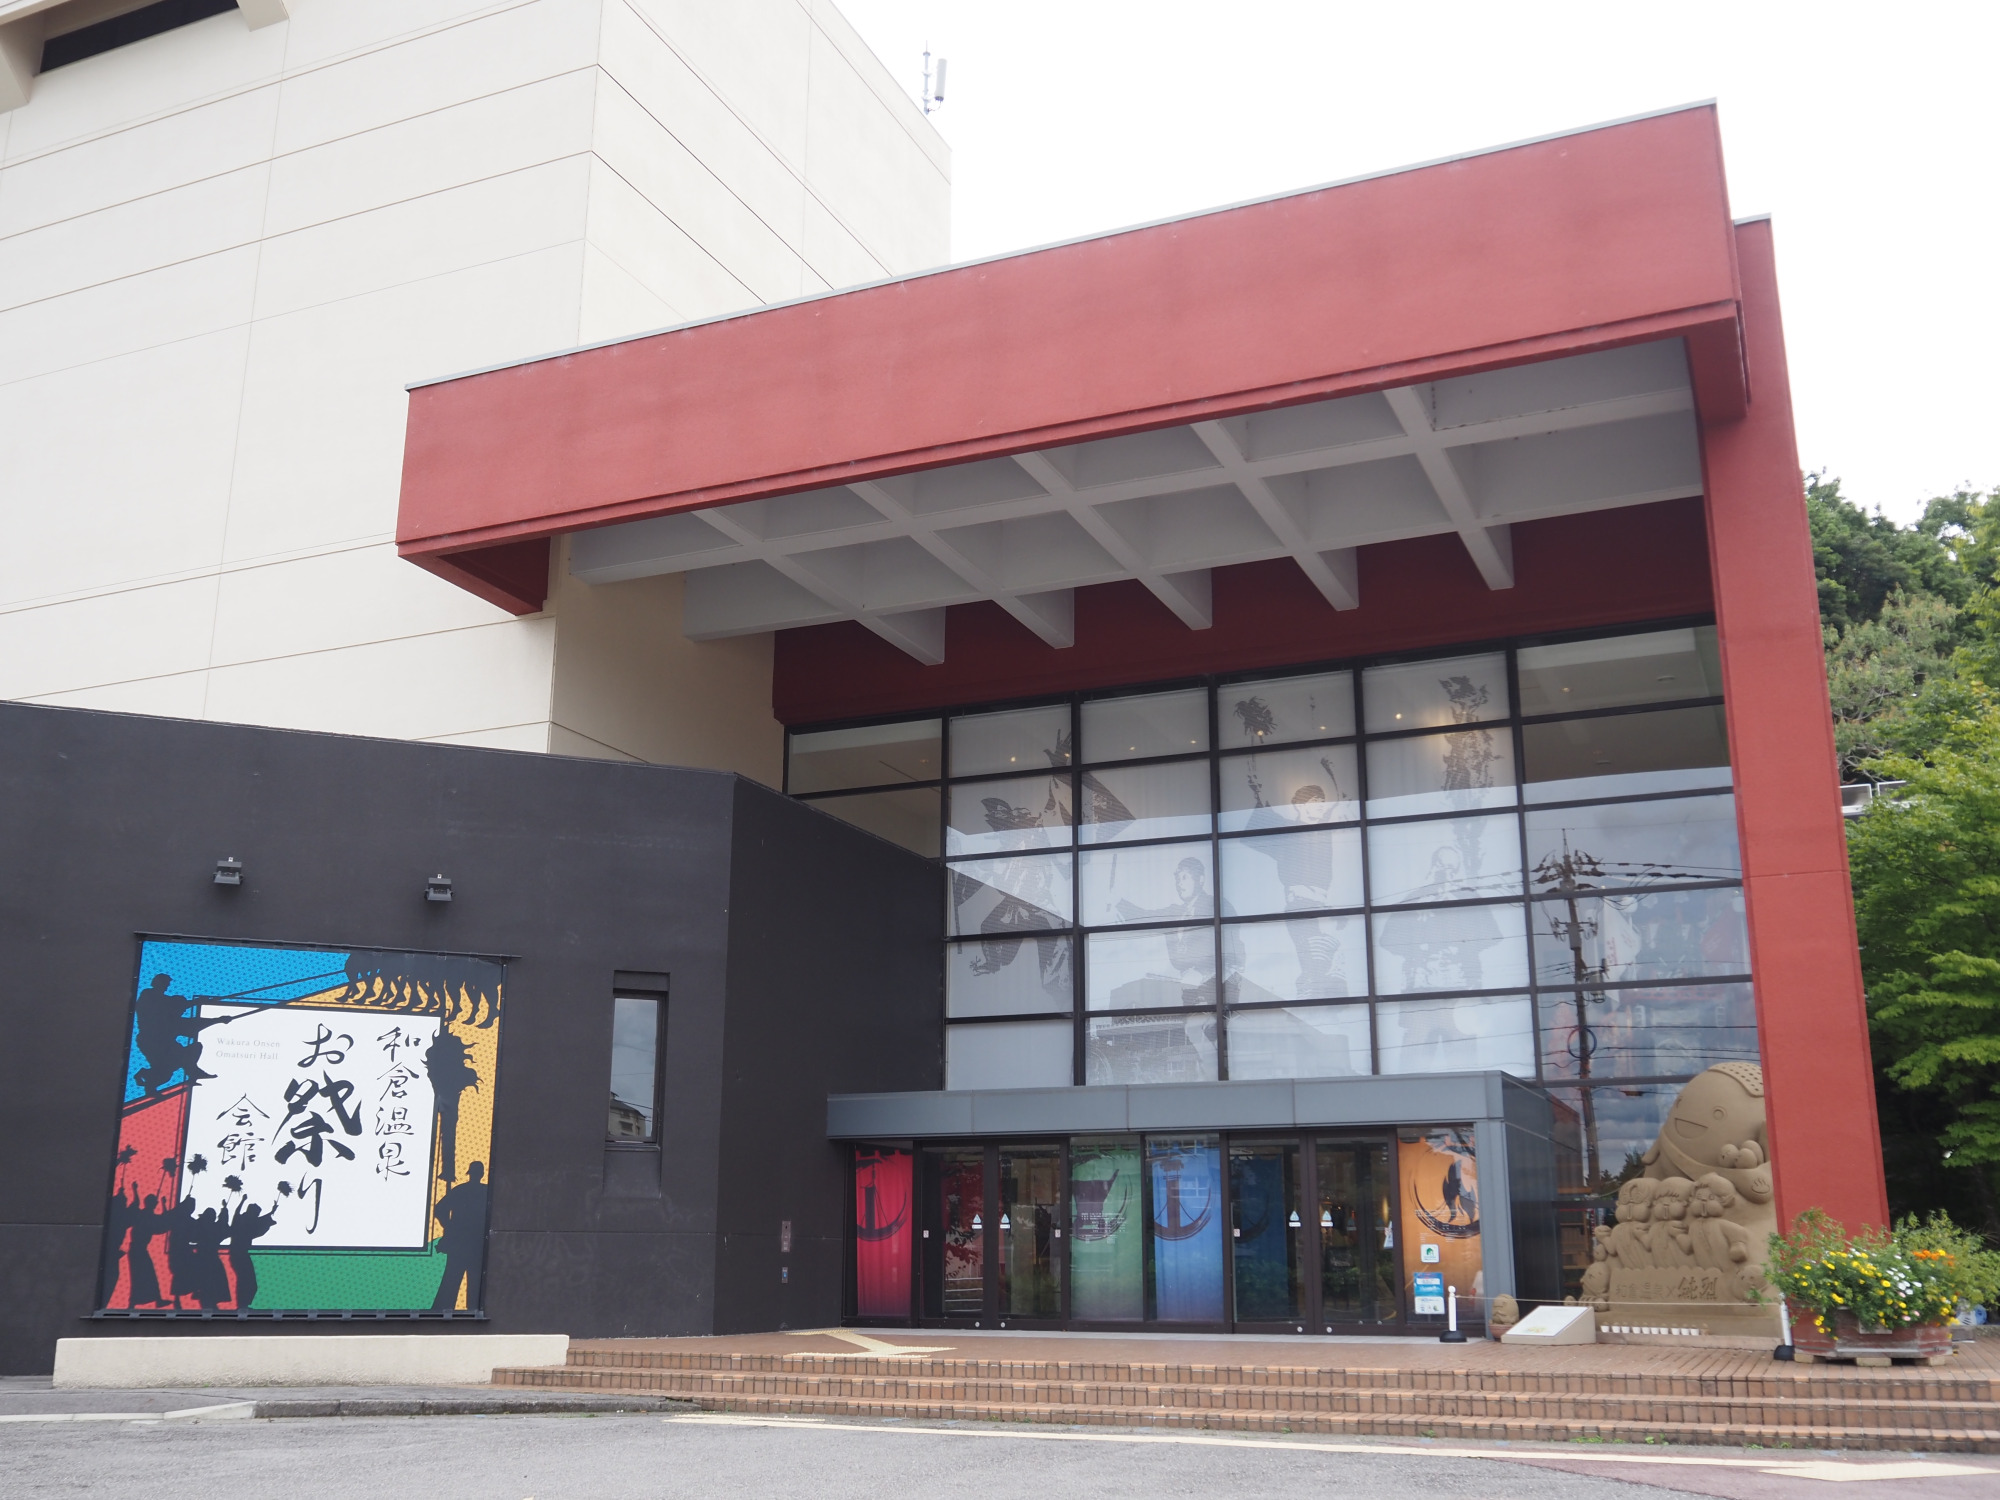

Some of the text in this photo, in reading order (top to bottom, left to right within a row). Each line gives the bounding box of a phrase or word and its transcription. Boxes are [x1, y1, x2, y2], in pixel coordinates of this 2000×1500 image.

[215, 1050, 278, 1060] Omatsuri Hall
[216, 1037, 280, 1048] Wakura Onsen
[216, 1093, 270, 1172] 会館
[272, 1023, 363, 1234] お祭り
[375, 1026, 421, 1182] 和倉温泉
